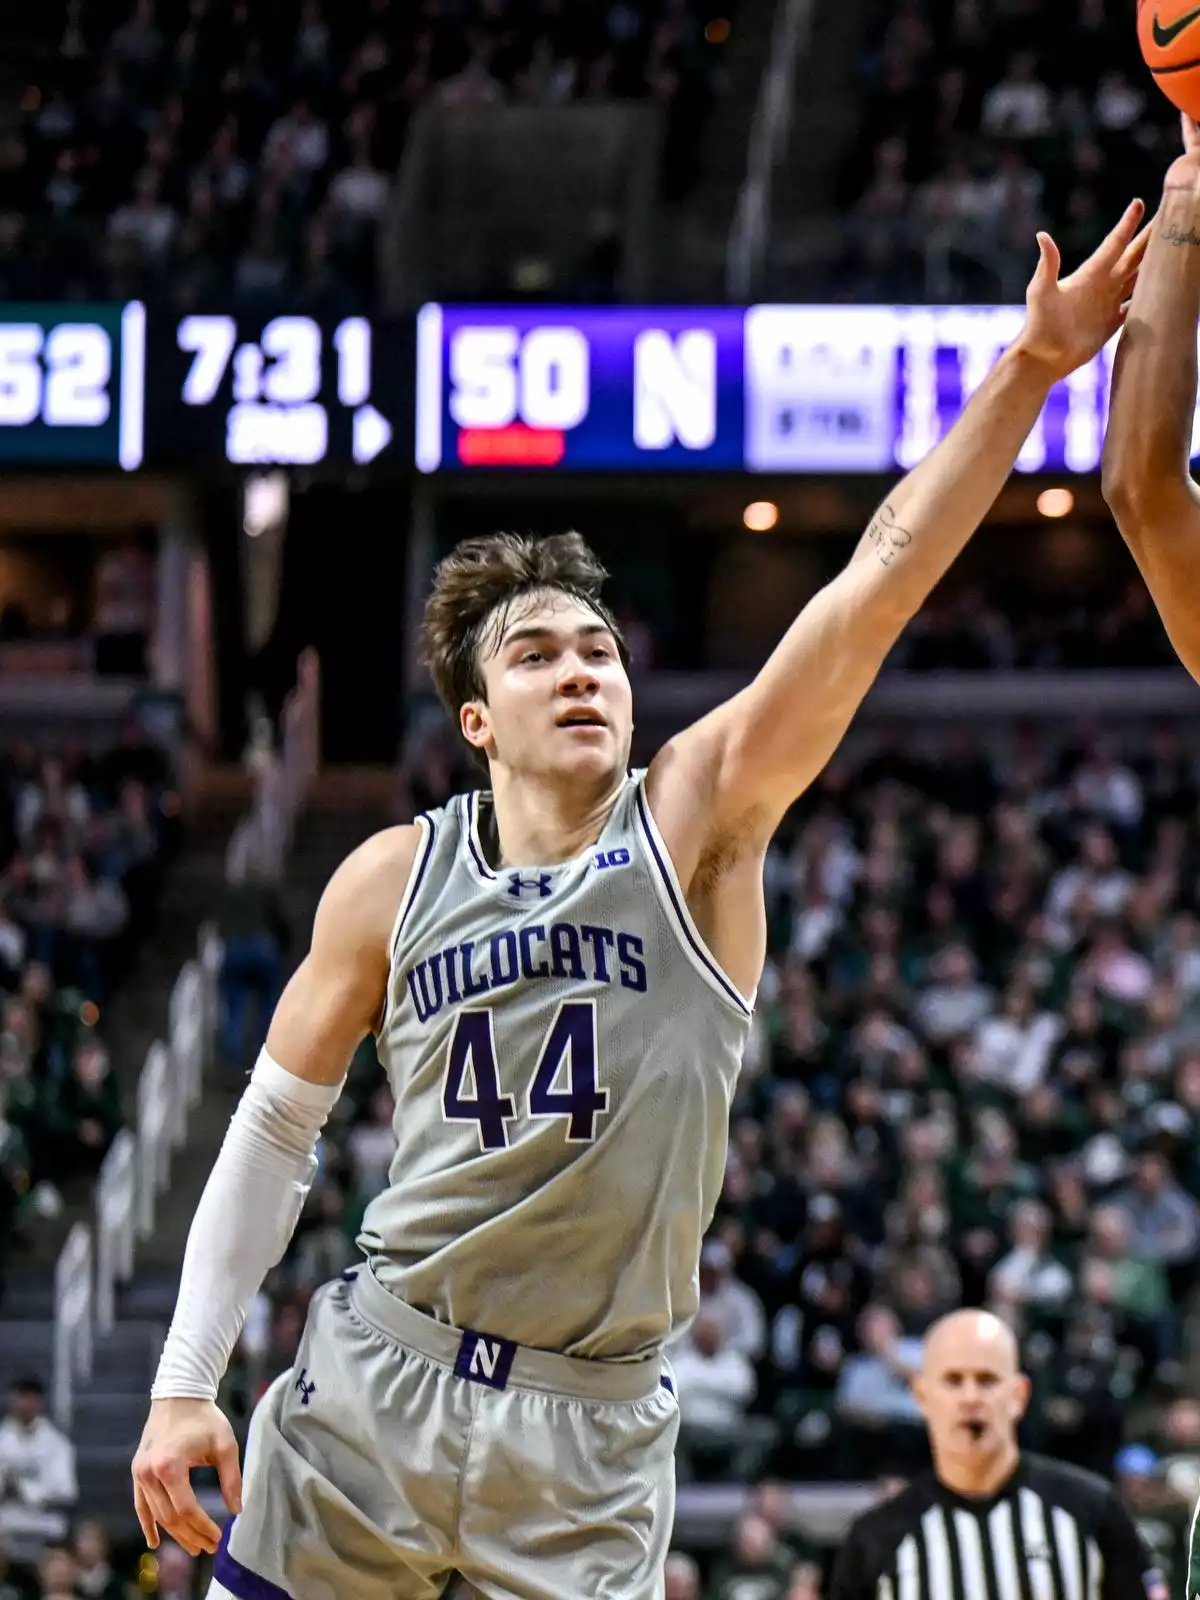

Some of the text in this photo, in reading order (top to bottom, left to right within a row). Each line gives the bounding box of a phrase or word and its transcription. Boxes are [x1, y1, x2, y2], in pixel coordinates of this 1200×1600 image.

[0, 322, 111, 426] 52
[177, 315, 371, 406] 7:31
[449, 325, 591, 430] 50
[633, 328, 717, 450] N
[407, 923, 647, 1024] WILDCATS
[441, 998, 610, 1152] 44
[468, 1337, 502, 1380] N
